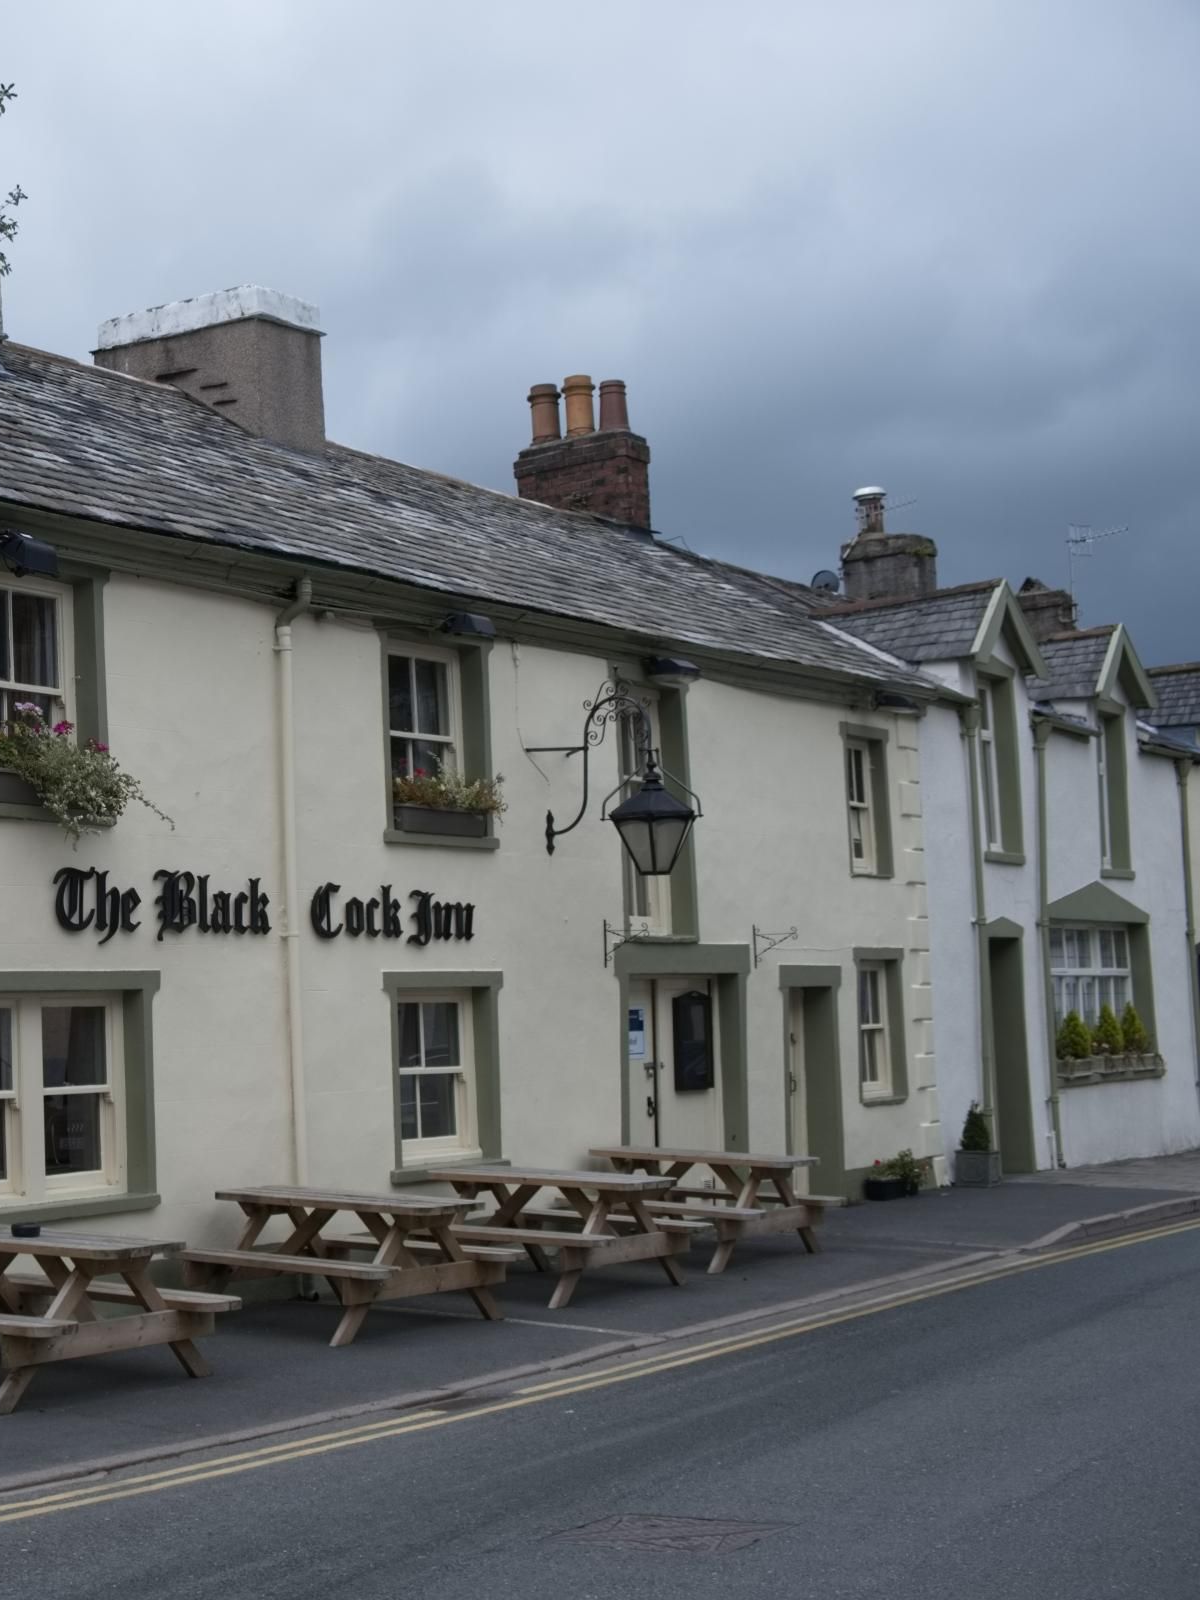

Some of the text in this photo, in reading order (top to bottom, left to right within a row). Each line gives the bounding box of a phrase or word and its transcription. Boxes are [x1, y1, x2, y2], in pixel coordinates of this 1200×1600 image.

[53, 866, 476, 946] The Black Cock Inn
